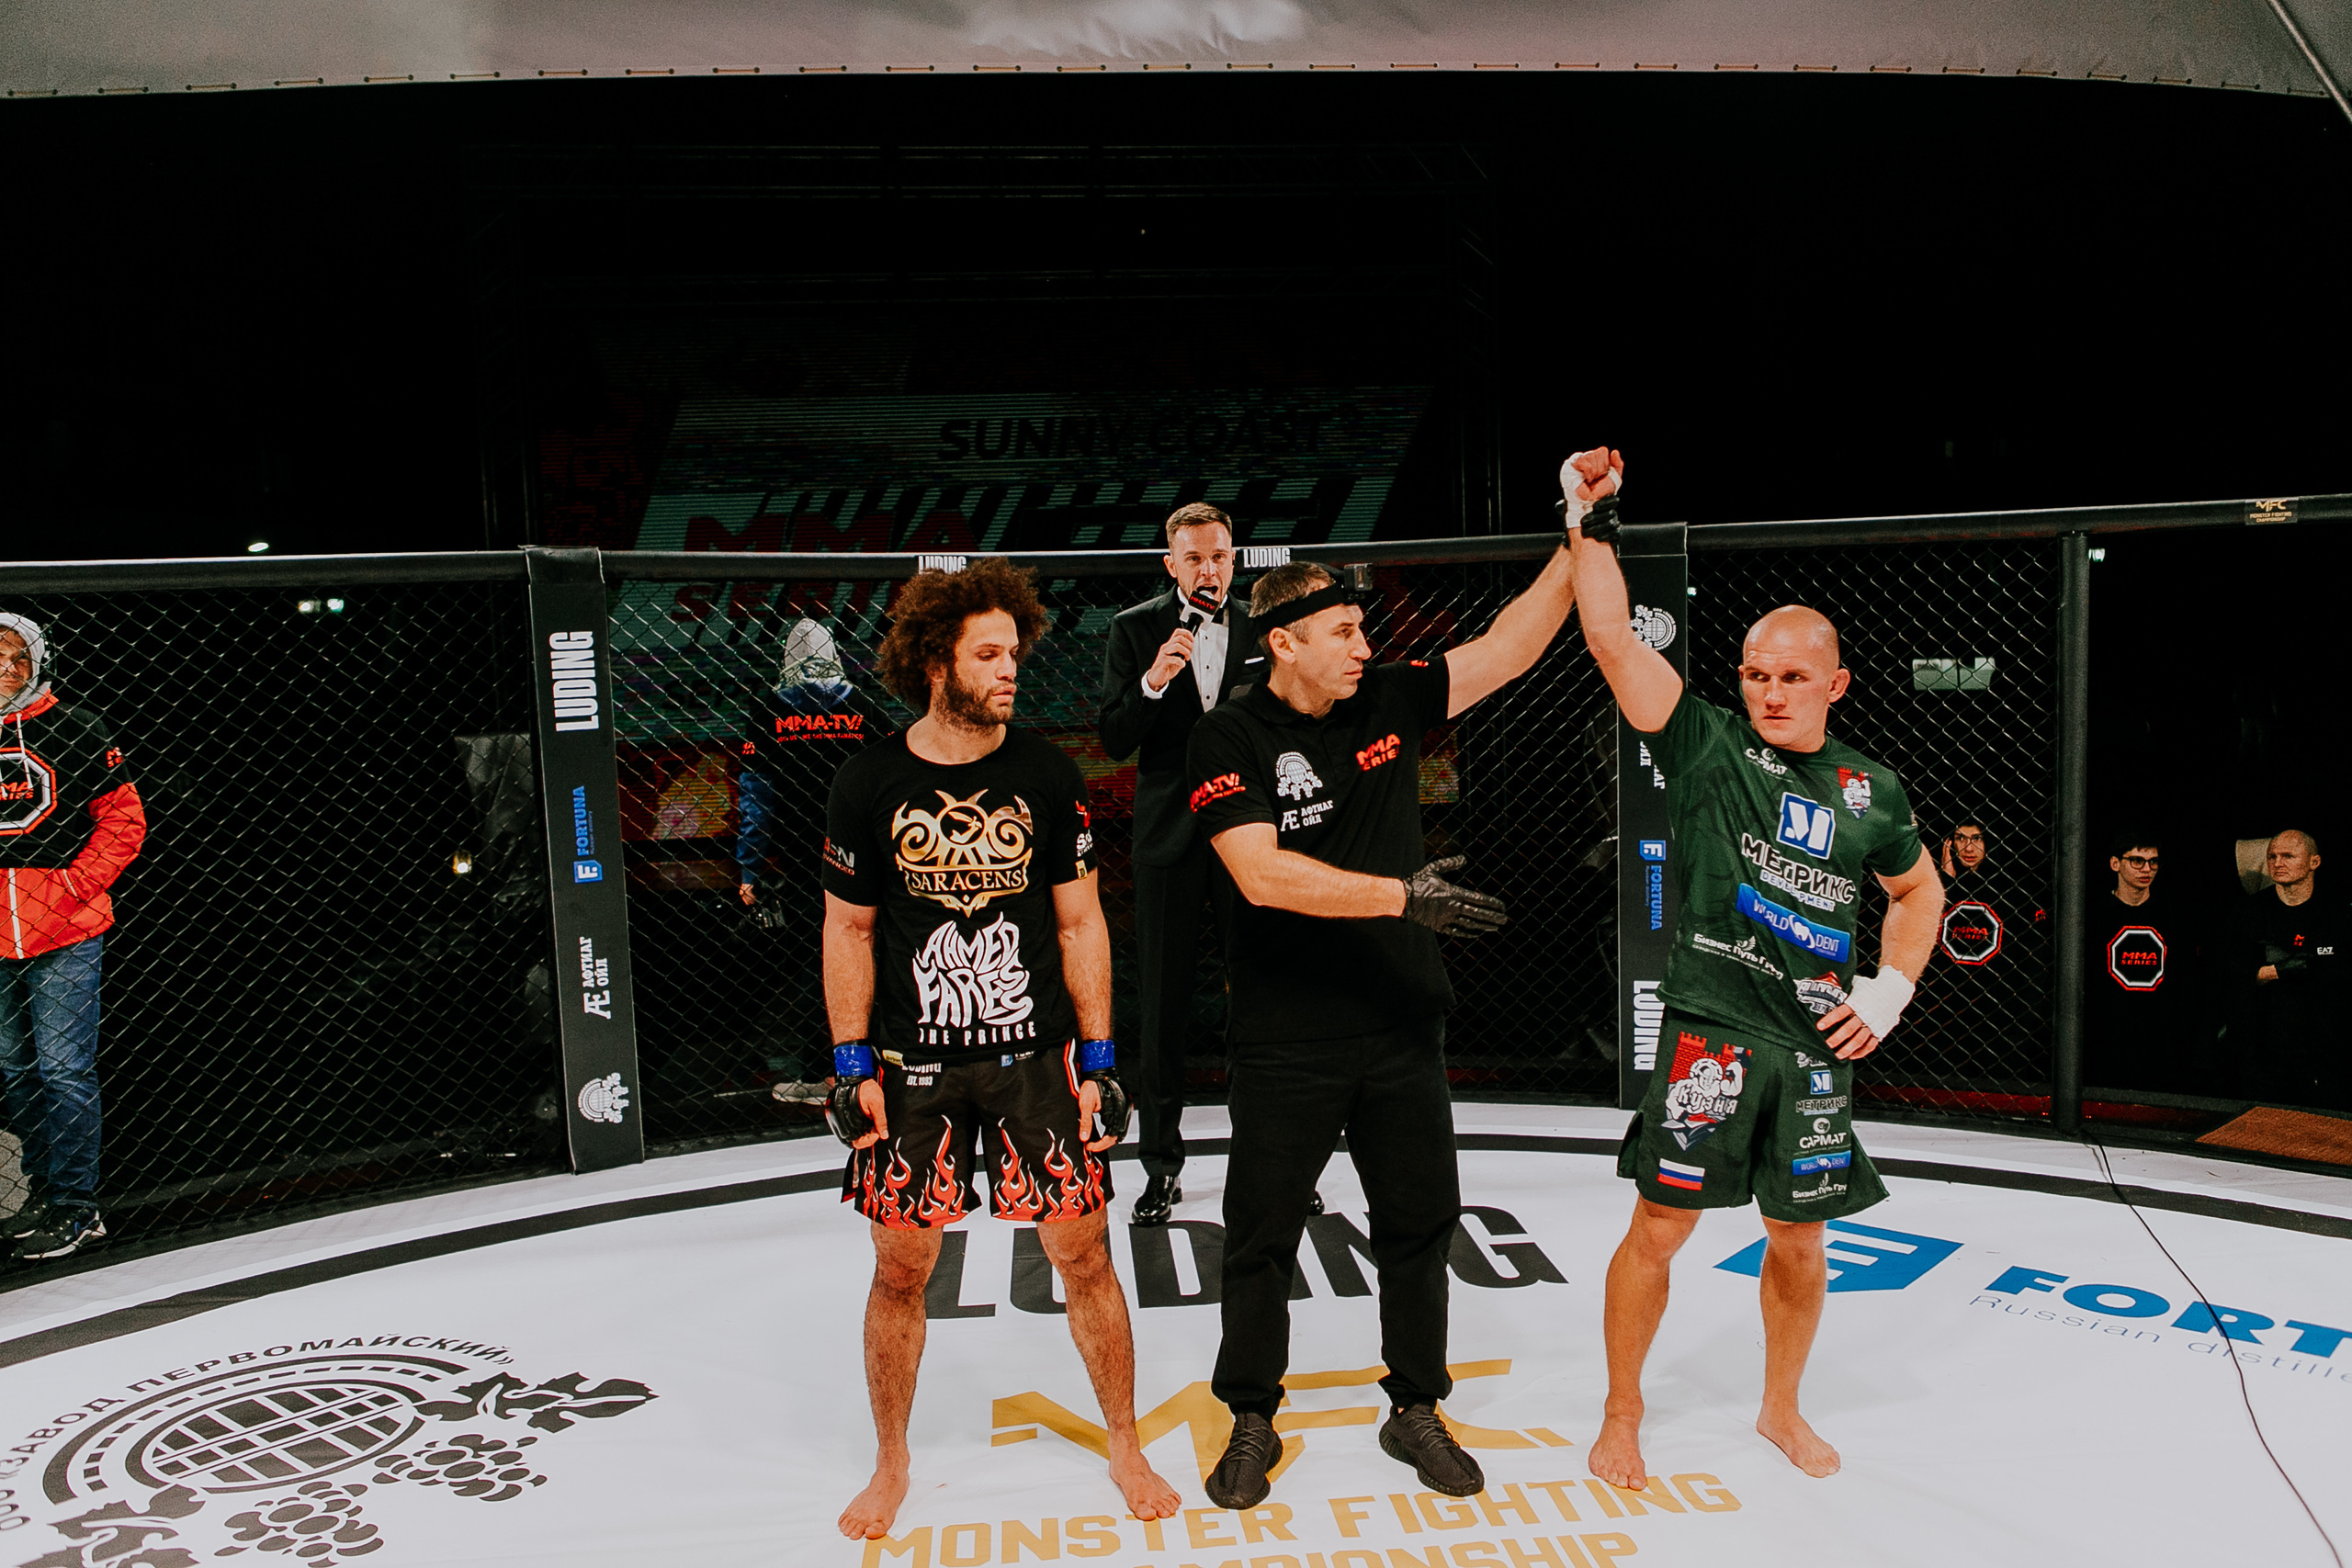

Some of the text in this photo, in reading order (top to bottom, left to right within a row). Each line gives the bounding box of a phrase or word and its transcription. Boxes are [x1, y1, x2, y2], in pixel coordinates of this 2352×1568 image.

[939, 417, 1132, 461] SUNNY
[1243, 547, 1291, 568] LUDING
[549, 631, 599, 732] LUDING
[1356, 734, 1400, 765] MMA
[572, 785, 589, 856] FORTUNA
[911, 870, 1023, 893] SARACENS
[1650, 864, 1663, 931] FORTUNA
[916, 911, 1023, 975] AHMED
[913, 957, 1034, 1028] FARES
[964, 1021, 1035, 1046] PRINCE
[1799, 1133, 1847, 1149] САРМАТ
[1969, 1293, 2161, 1345] Russian
[860, 1472, 1742, 1568] MONSTER FIGHTING
